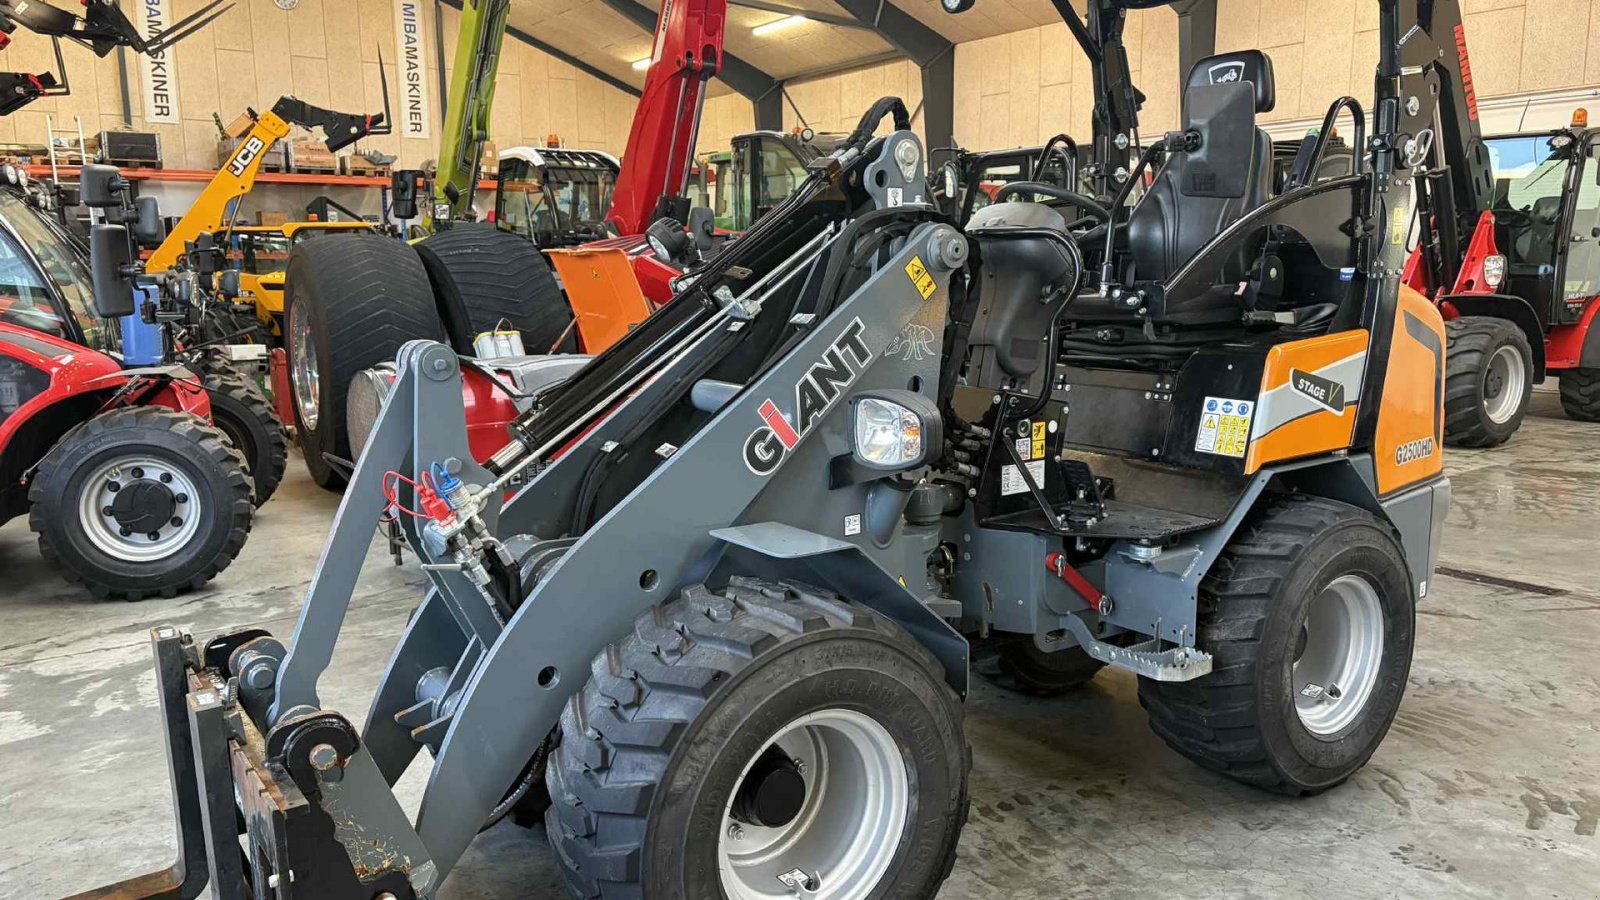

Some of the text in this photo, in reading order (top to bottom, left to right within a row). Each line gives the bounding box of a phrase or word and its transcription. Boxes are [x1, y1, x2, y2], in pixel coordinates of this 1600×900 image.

[402, 3, 423, 133] MIBAMASKINER
[1453, 24, 1478, 121] MANITOU
[231, 136, 265, 177] JCB
[1298, 378, 1326, 400] STAGE
[1395, 437, 1433, 466] G2500HD
